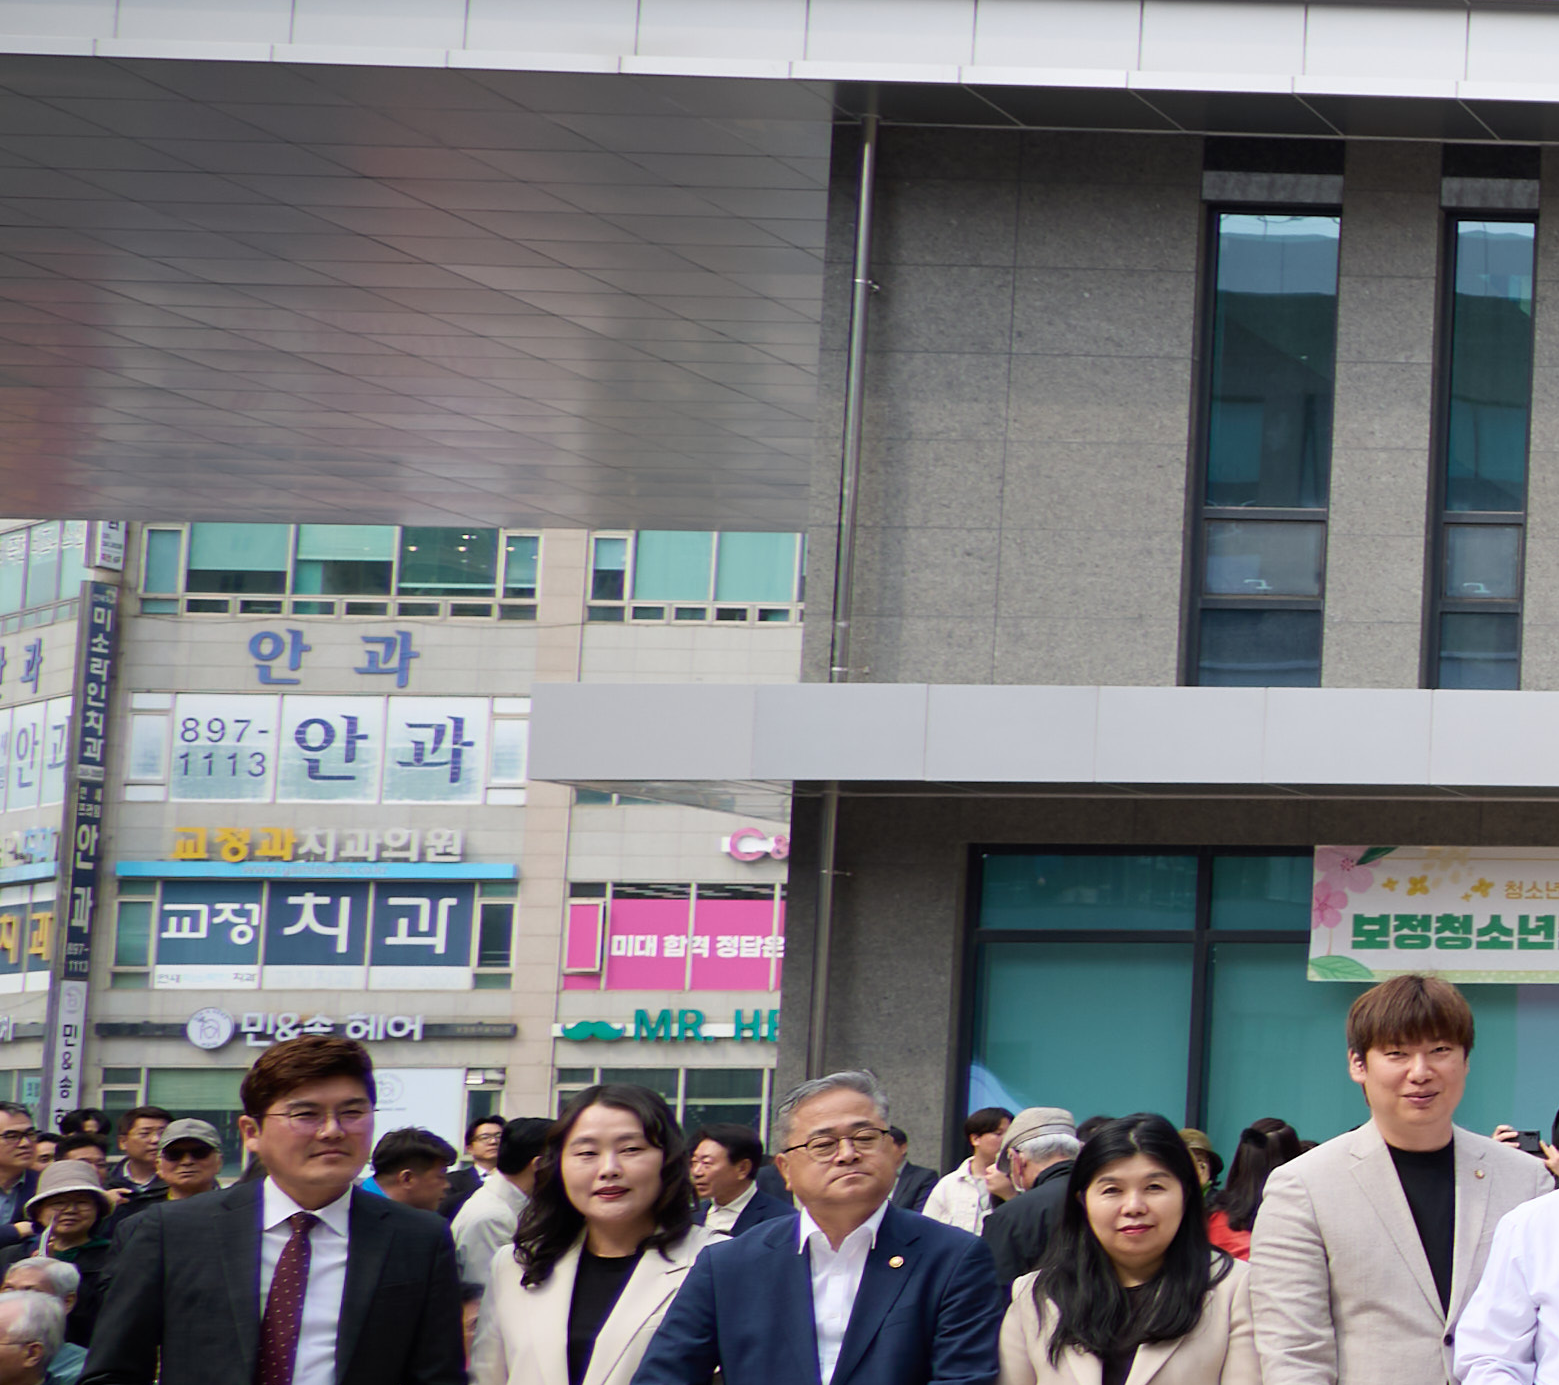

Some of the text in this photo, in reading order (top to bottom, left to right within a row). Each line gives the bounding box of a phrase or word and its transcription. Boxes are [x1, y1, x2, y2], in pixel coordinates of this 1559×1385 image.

[181, 717, 269, 743] 897-
[179, 751, 266, 777] 1113
[161, 902, 260, 945] 교정
[611, 934, 658, 957] 미대
[663, 934, 710, 958] 합격
[345, 1014, 424, 1041] 헤어
[633, 1009, 714, 1042] MR.
